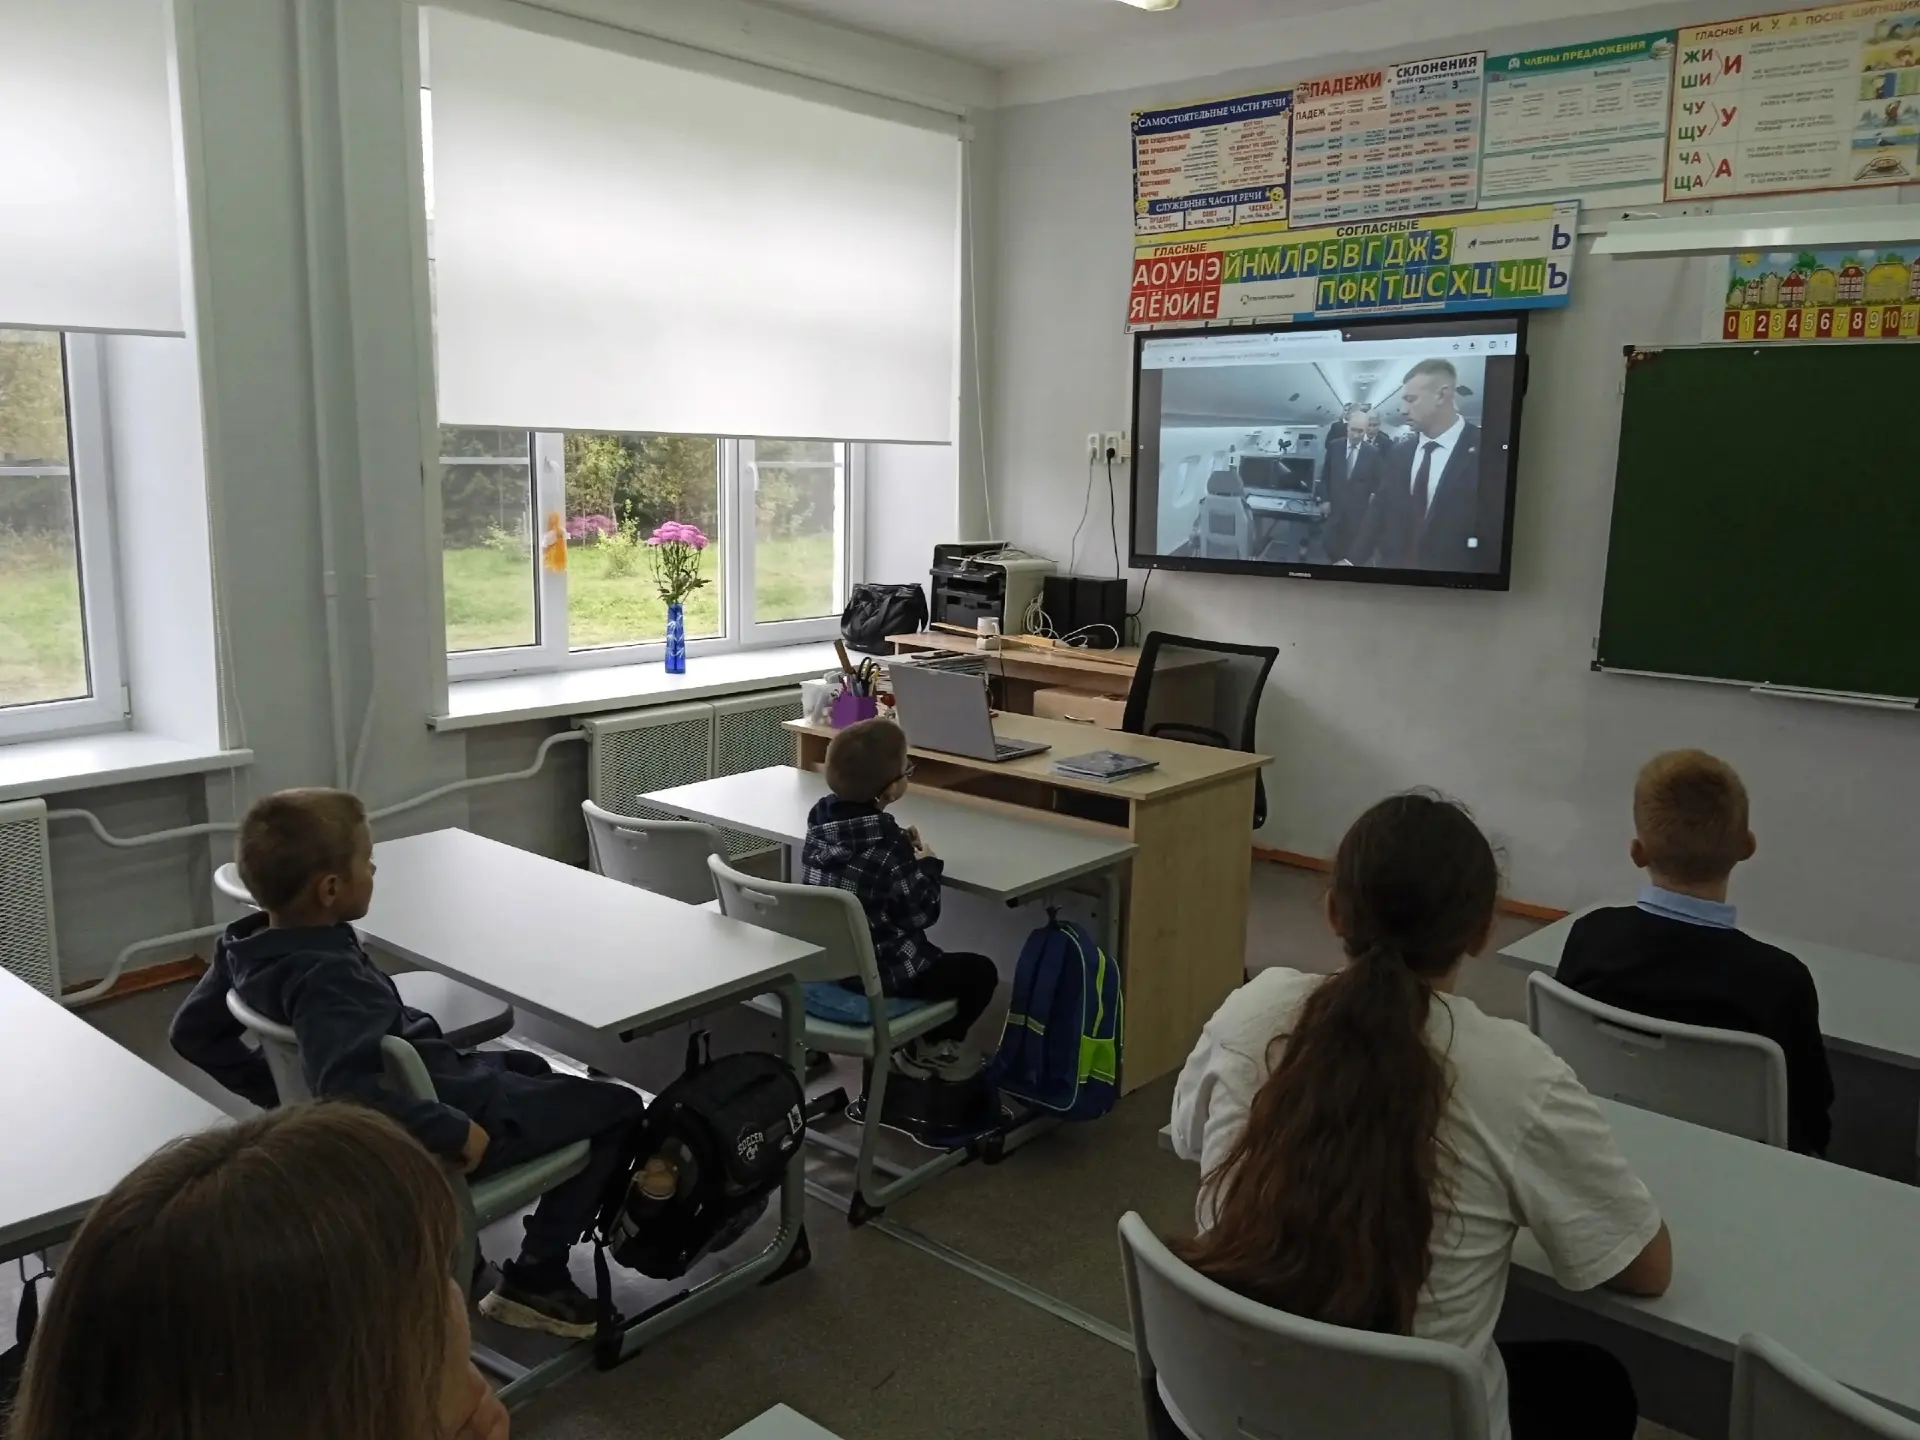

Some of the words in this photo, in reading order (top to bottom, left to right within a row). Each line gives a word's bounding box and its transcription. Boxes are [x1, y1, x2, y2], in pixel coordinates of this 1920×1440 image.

[1695, 25, 1744, 40] ГЛАСНЫЕ
[1788, 16, 1798, 27] А
[1806, 11, 1844, 25] ПОСЛЕ
[1524, 55, 1559, 66] ЧЛЕНЫ
[1563, 40, 1646, 61] ПРЕДЛОЖЕНИЯ
[1724, 54, 1742, 75] И
[1310, 72, 1382, 98] ПАДЕЖИ
[1418, 86, 1426, 94] 2
[1452, 80, 1459, 90] 3
[1138, 106, 1228, 128] САМОСТОЯТЕЛЬНЫЕ
[1230, 101, 1260, 114] ЧАСТИ
[1262, 97, 1287, 110] РЕЧИ
[1296, 107, 1326, 120] ПАДЕЖ
[1721, 106, 1737, 127] У
[1715, 158, 1732, 178] А
[1156, 198, 1207, 213] СЛУЖЕБНЫЕ
[1208, 195, 1238, 206] ЧАСТИ
[1239, 191, 1262, 202] РЕЧИ
[1336, 219, 1419, 238] СОГЛАСНЫЕ
[1154, 243, 1207, 257] ГЛАСНЫЕ
[1728, 316, 1737, 332] 0
[1743, 315, 1750, 332] 1
[1757, 315, 1767, 332] 2
[1772, 315, 1782, 331] 3
[1788, 314, 1798, 331] 4
[1804, 313, 1814, 331] 5
[1820, 313, 1830, 330] 6
[1837, 313, 1847, 330] 7
[1852, 312, 1863, 329] 8
[1869, 312, 1879, 329] 9
[1884, 311, 1899, 328] 10
[737, 1132, 765, 1156] SOCCER
